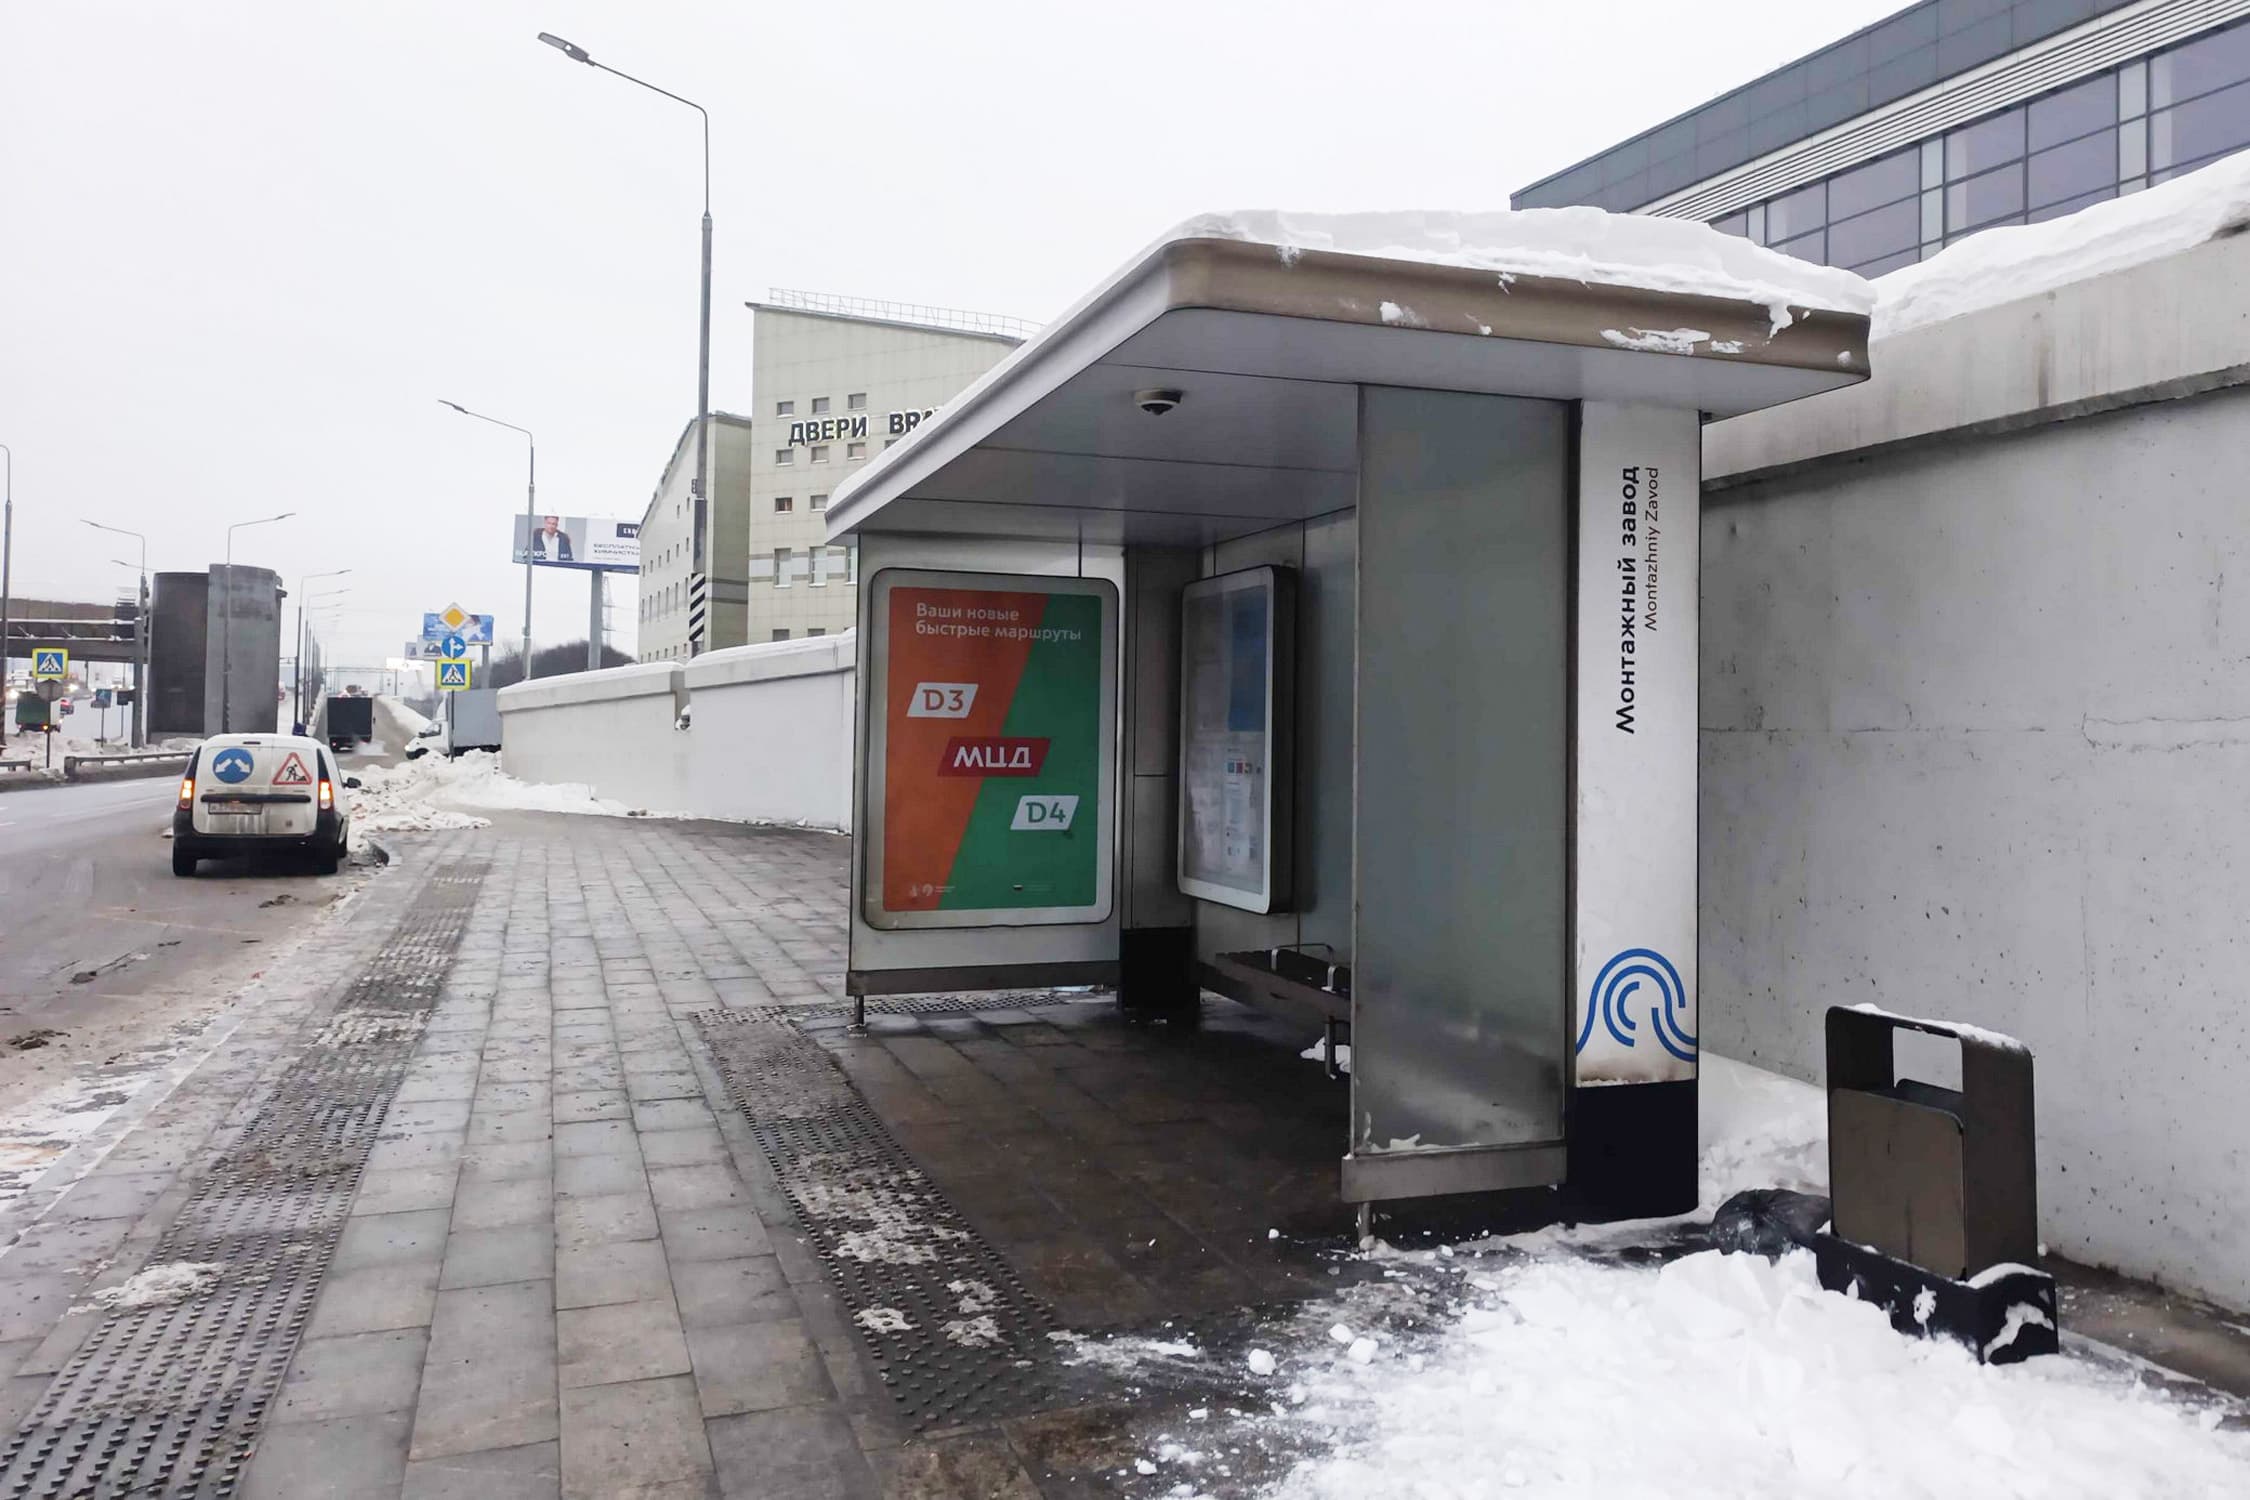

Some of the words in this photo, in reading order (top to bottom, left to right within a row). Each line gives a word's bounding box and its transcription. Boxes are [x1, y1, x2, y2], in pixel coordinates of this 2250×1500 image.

[789, 417, 867, 447] ДВЕРИ
[1622, 465, 1640, 546] завод
[1645, 466, 1659, 523] Zavod
[1645, 528, 1661, 631] Montazhniy
[916, 602, 962, 619] Ваши
[967, 607, 1020, 621] новые
[915, 619, 991, 639] быстрые
[994, 625, 1082, 643] маршруты
[1616, 559, 1636, 734] Монтажный
[922, 689, 965, 711] D3
[953, 746, 1032, 769] МЦД
[1025, 802, 1067, 824] D4
